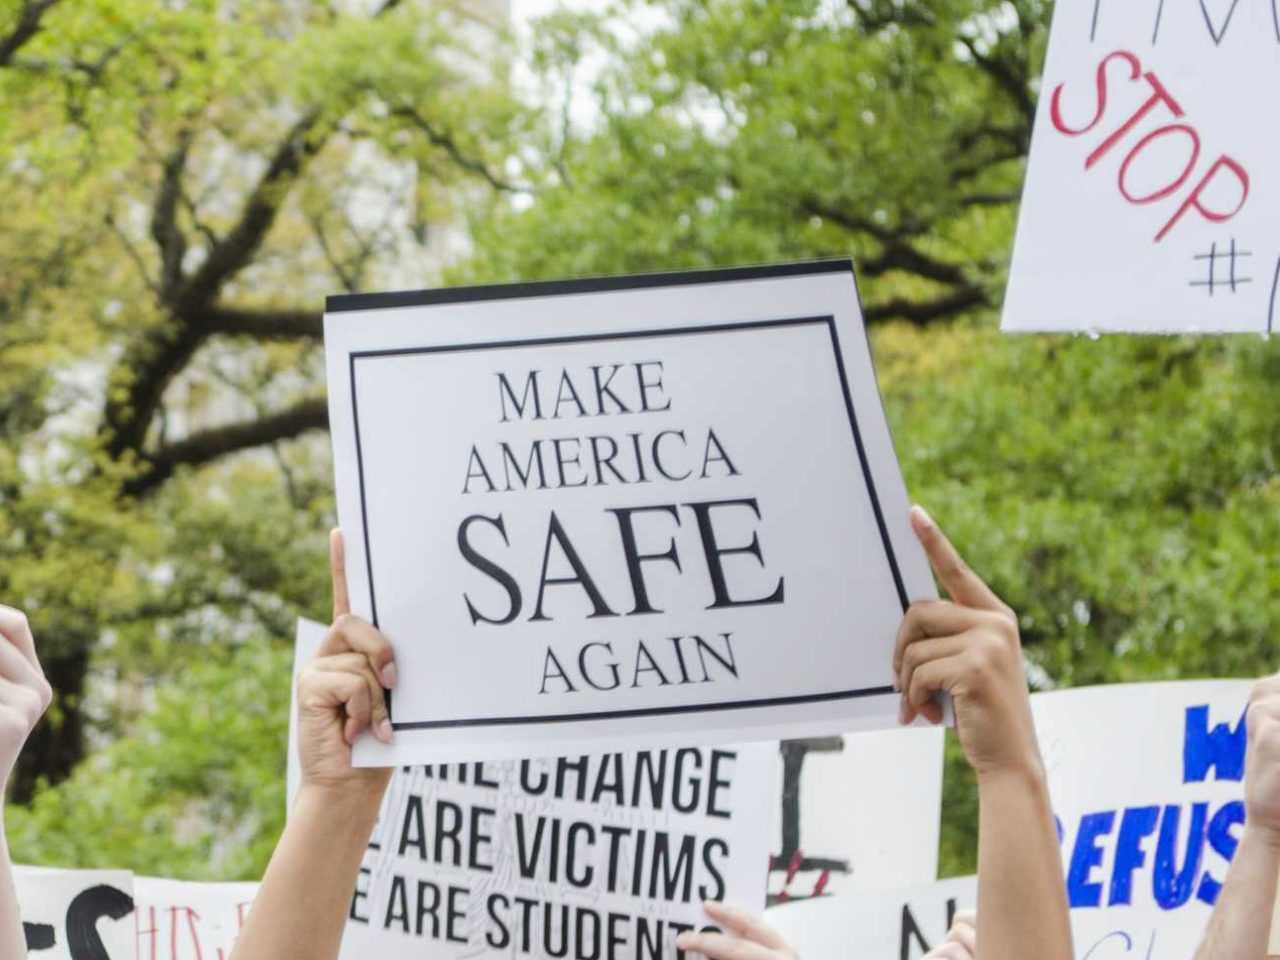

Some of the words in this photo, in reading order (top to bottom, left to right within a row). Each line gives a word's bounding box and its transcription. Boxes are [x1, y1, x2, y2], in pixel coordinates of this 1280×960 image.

[1050, 50, 1250, 243] STOP
[495, 360, 672, 422] MAKE
[461, 427, 742, 494] AMERICA
[456, 497, 785, 628] SAFE
[538, 632, 741, 695] AGAIN
[1183, 703, 1247, 785] W
[520, 747, 737, 819] CHANGE
[397, 795, 496, 872] ARE
[514, 813, 730, 904] VICTIMS
[1055, 800, 1247, 911] EFUS
[384, 875, 471, 944] ARE
